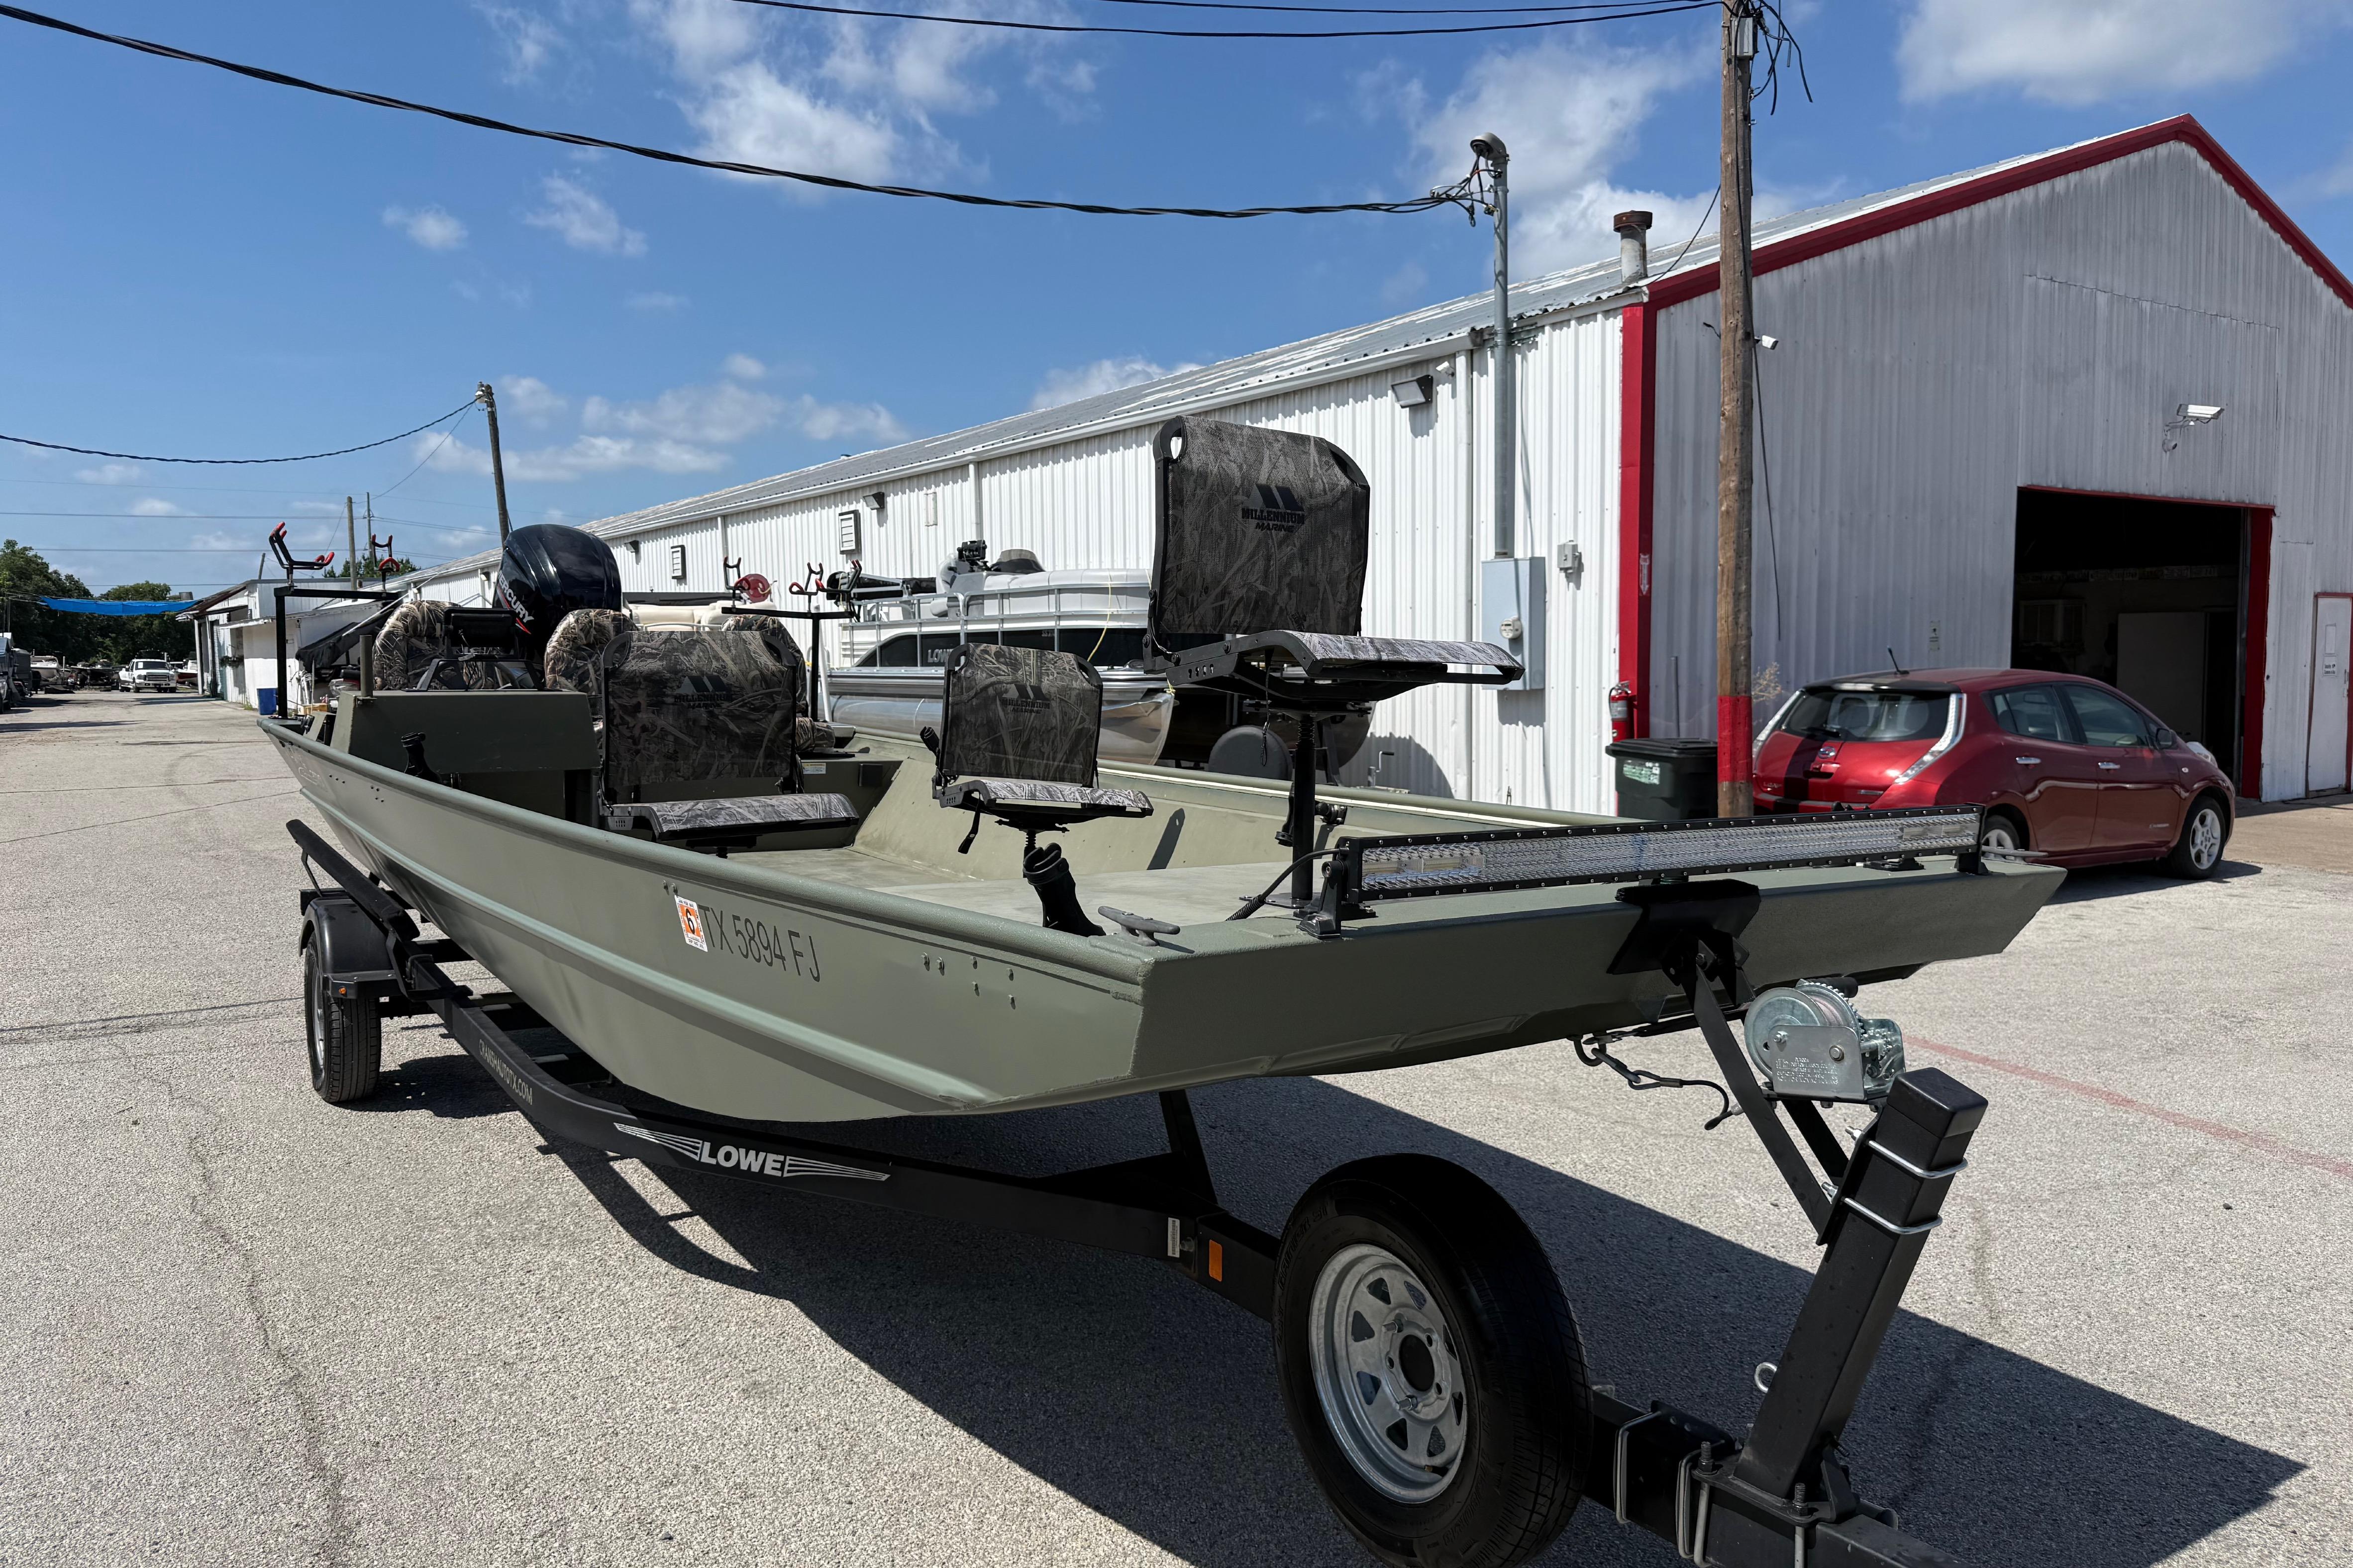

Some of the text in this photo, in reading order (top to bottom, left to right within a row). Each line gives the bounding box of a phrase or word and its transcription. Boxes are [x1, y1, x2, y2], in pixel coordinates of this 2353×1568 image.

[1241, 507, 1305, 524] MILLENNIUM
[1255, 521, 1295, 533] MARINE
[1001, 697, 1050, 709] MILLENNIUM
[686, 908, 695, 935] 6
[698, 904, 820, 982] TX 5894 FJ
[700, 1141, 785, 1177] LOWE
